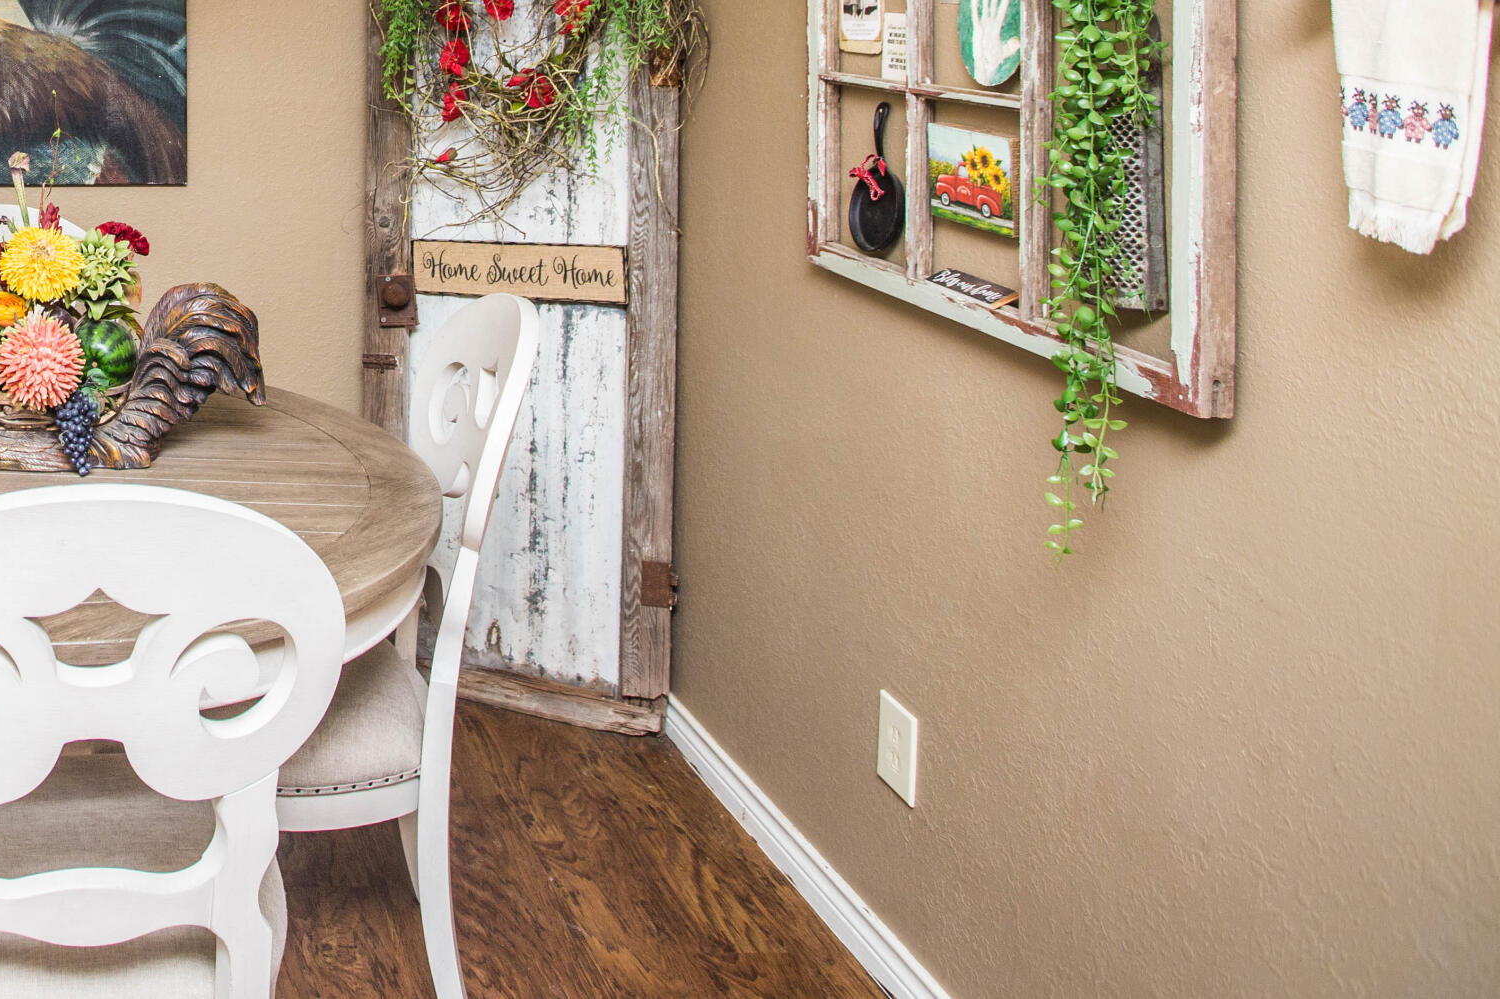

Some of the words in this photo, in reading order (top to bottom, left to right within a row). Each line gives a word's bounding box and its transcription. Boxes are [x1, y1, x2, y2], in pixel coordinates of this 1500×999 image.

[422, 250, 481, 284] Home
[486, 252, 549, 287] Sweet
[553, 253, 618, 290] Home
